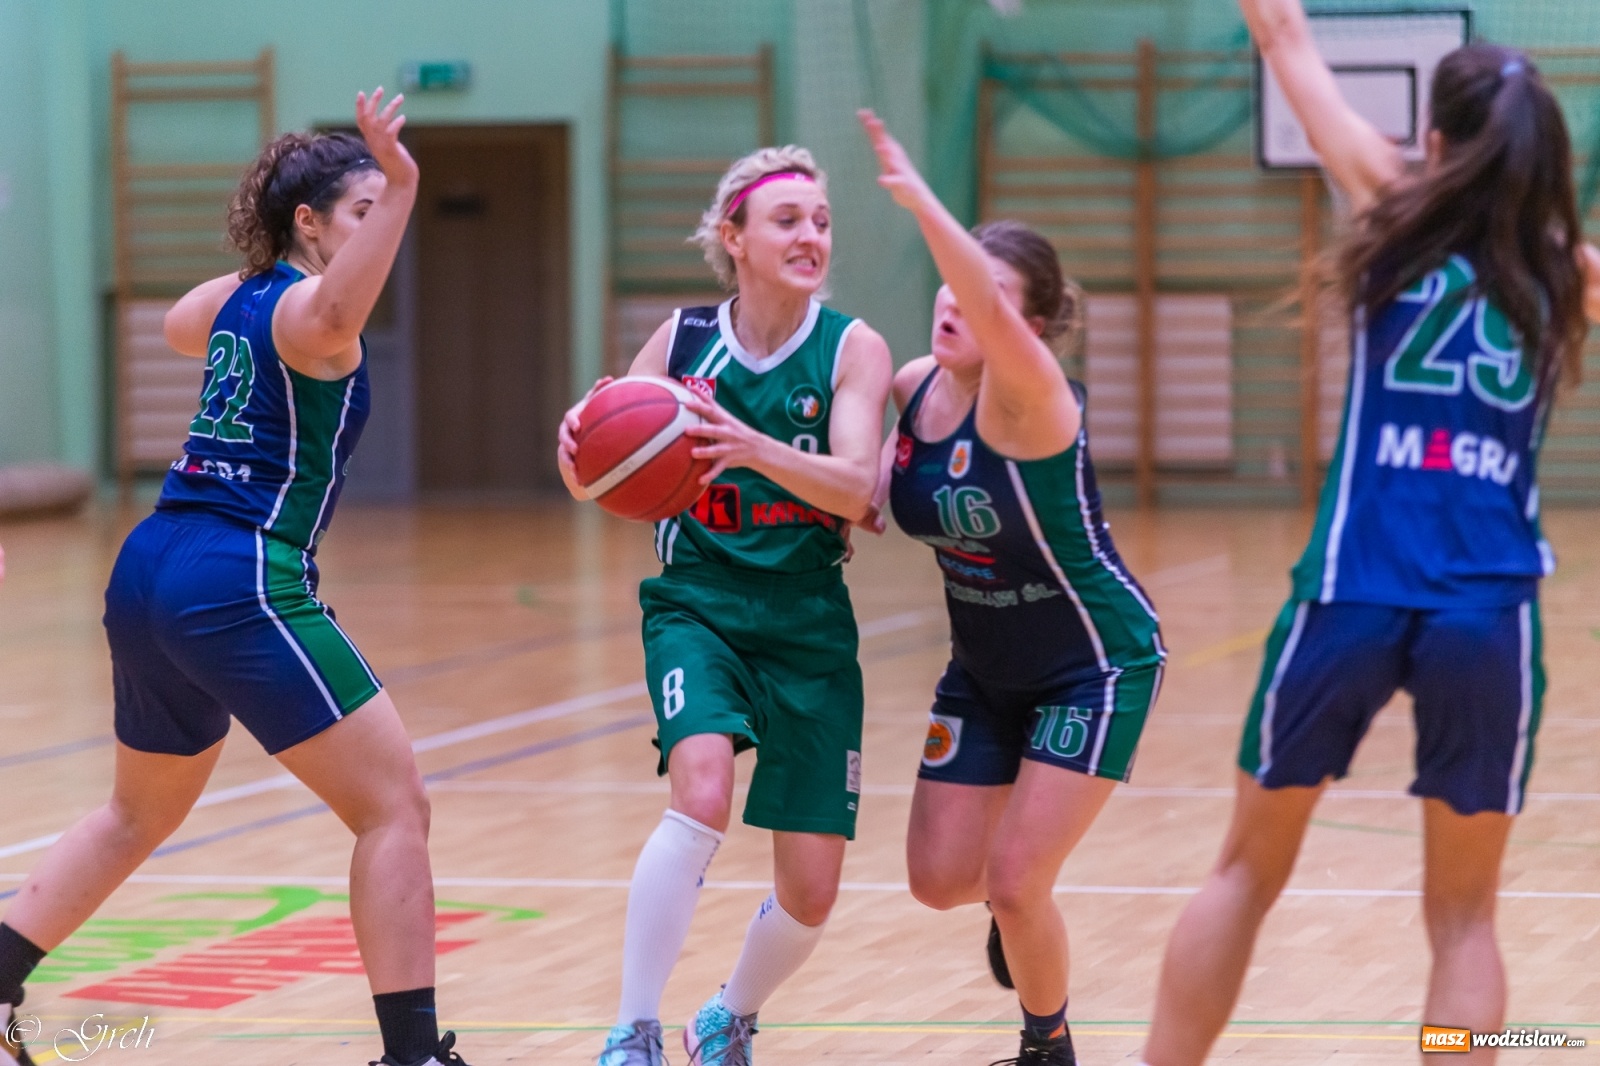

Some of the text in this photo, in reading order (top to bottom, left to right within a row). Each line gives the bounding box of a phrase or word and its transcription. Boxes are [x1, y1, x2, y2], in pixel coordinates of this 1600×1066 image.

[1383, 254, 1536, 412] 29
[189, 331, 255, 443] 22
[932, 485, 1001, 539] 16
[662, 667, 685, 720] 8
[1031, 706, 1092, 758] 16
